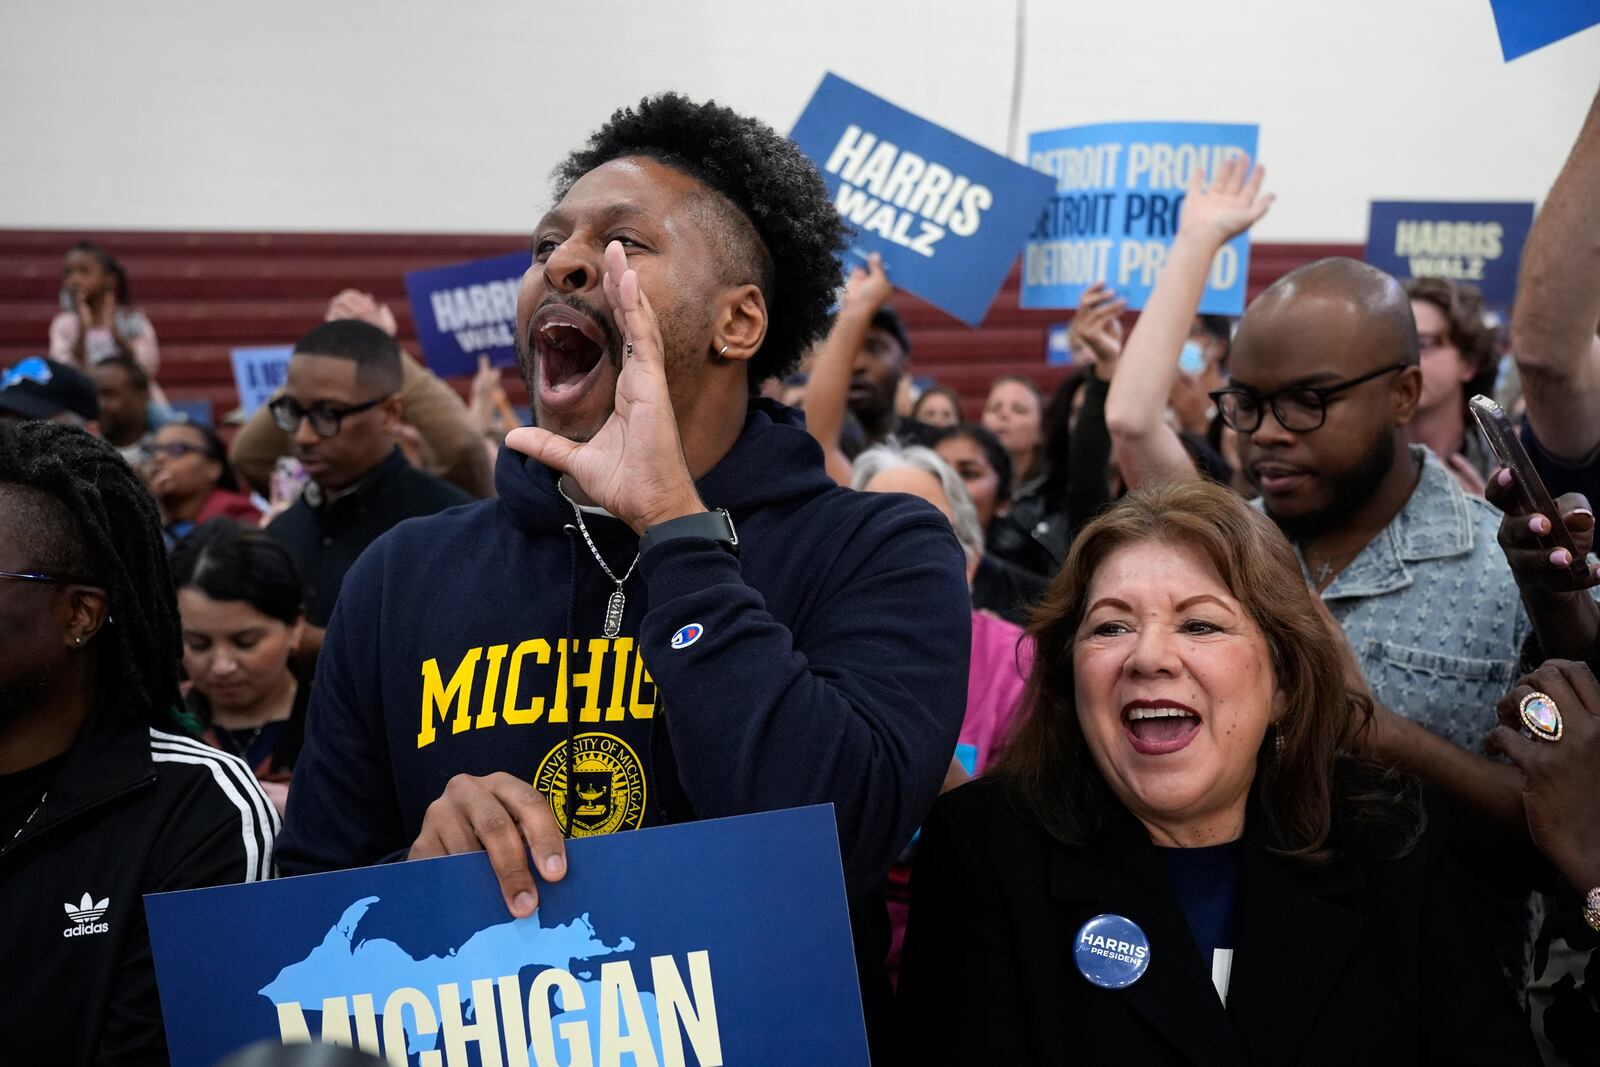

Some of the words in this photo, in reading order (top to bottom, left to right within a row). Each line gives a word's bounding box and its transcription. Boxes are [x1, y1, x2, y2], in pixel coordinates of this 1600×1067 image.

[824, 124, 993, 237] HARRIS
[835, 183, 946, 258] WALZ
[1029, 193, 1116, 240] ETROIT
[1123, 192, 1185, 239] PRO
[1395, 219, 1504, 260] HARRIS
[1026, 240, 1113, 287] DETROIT
[1117, 239, 1239, 290] PRD
[1408, 256, 1486, 280] WALZ
[430, 278, 522, 333] HARRI
[455, 323, 515, 353] WAL
[417, 637, 658, 749] MICHIG
[600, 739, 619, 755] OF
[616, 748, 642, 827] MICHIGAN
[63, 922, 109, 938] adidas
[1080, 931, 1146, 959] HARRIS
[1075, 944, 1090, 953] for
[1090, 947, 1143, 967] PRESIDENT
